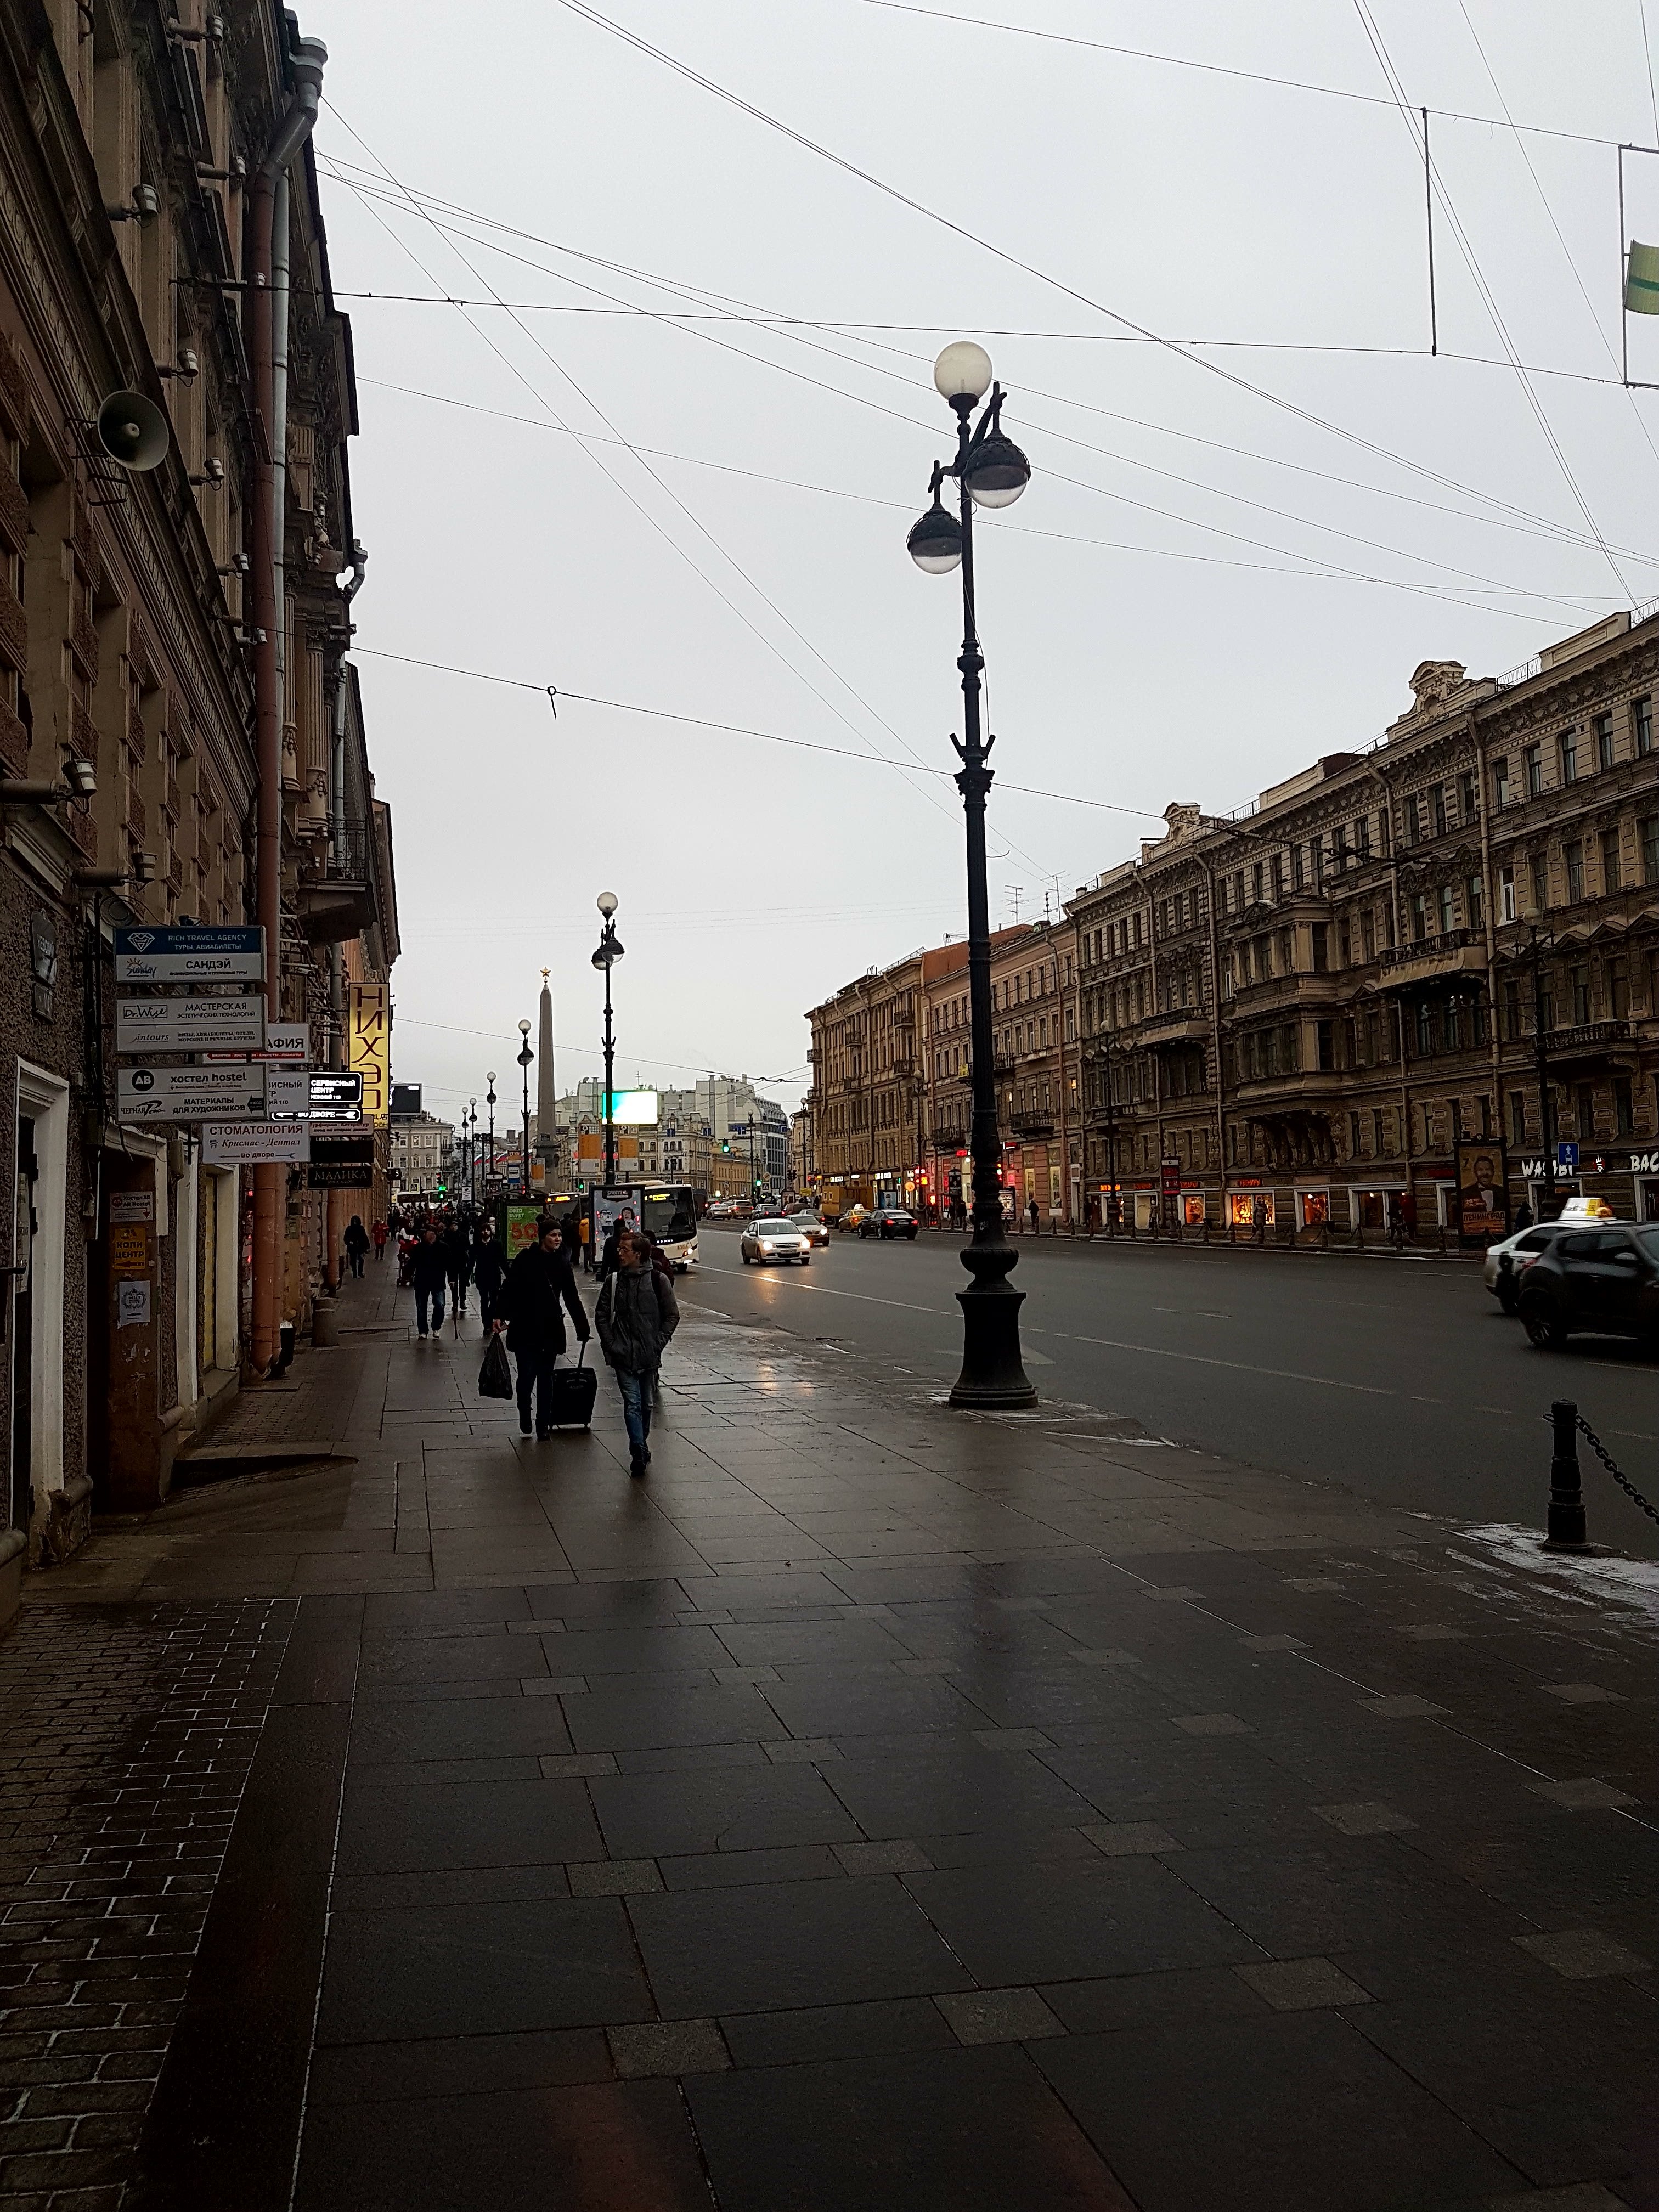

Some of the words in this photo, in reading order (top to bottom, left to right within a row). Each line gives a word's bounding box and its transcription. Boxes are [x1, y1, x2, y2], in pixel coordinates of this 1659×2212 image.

[186, 958, 231, 970] САНДЭЙ
[126, 964, 157, 978] Sunday
[185, 1003, 246, 1011] МАСТЕРСКАЯ
[212, 1072, 246, 1082] hostel
[269, 1080, 302, 1088] ИСНЫЙ
[173, 1107, 189, 1115] ДЛЯ
[191, 1105, 245, 1113] ХУДОЖНИКОВ
[210, 1125, 303, 1135] СТОМАТОЛОГИЯ
[266, 1138, 300, 1147] Дентал
[315, 1170, 367, 1180] МАЛИКА
[1464, 1212, 1504, 1221] ЛЕНИНГРАД
